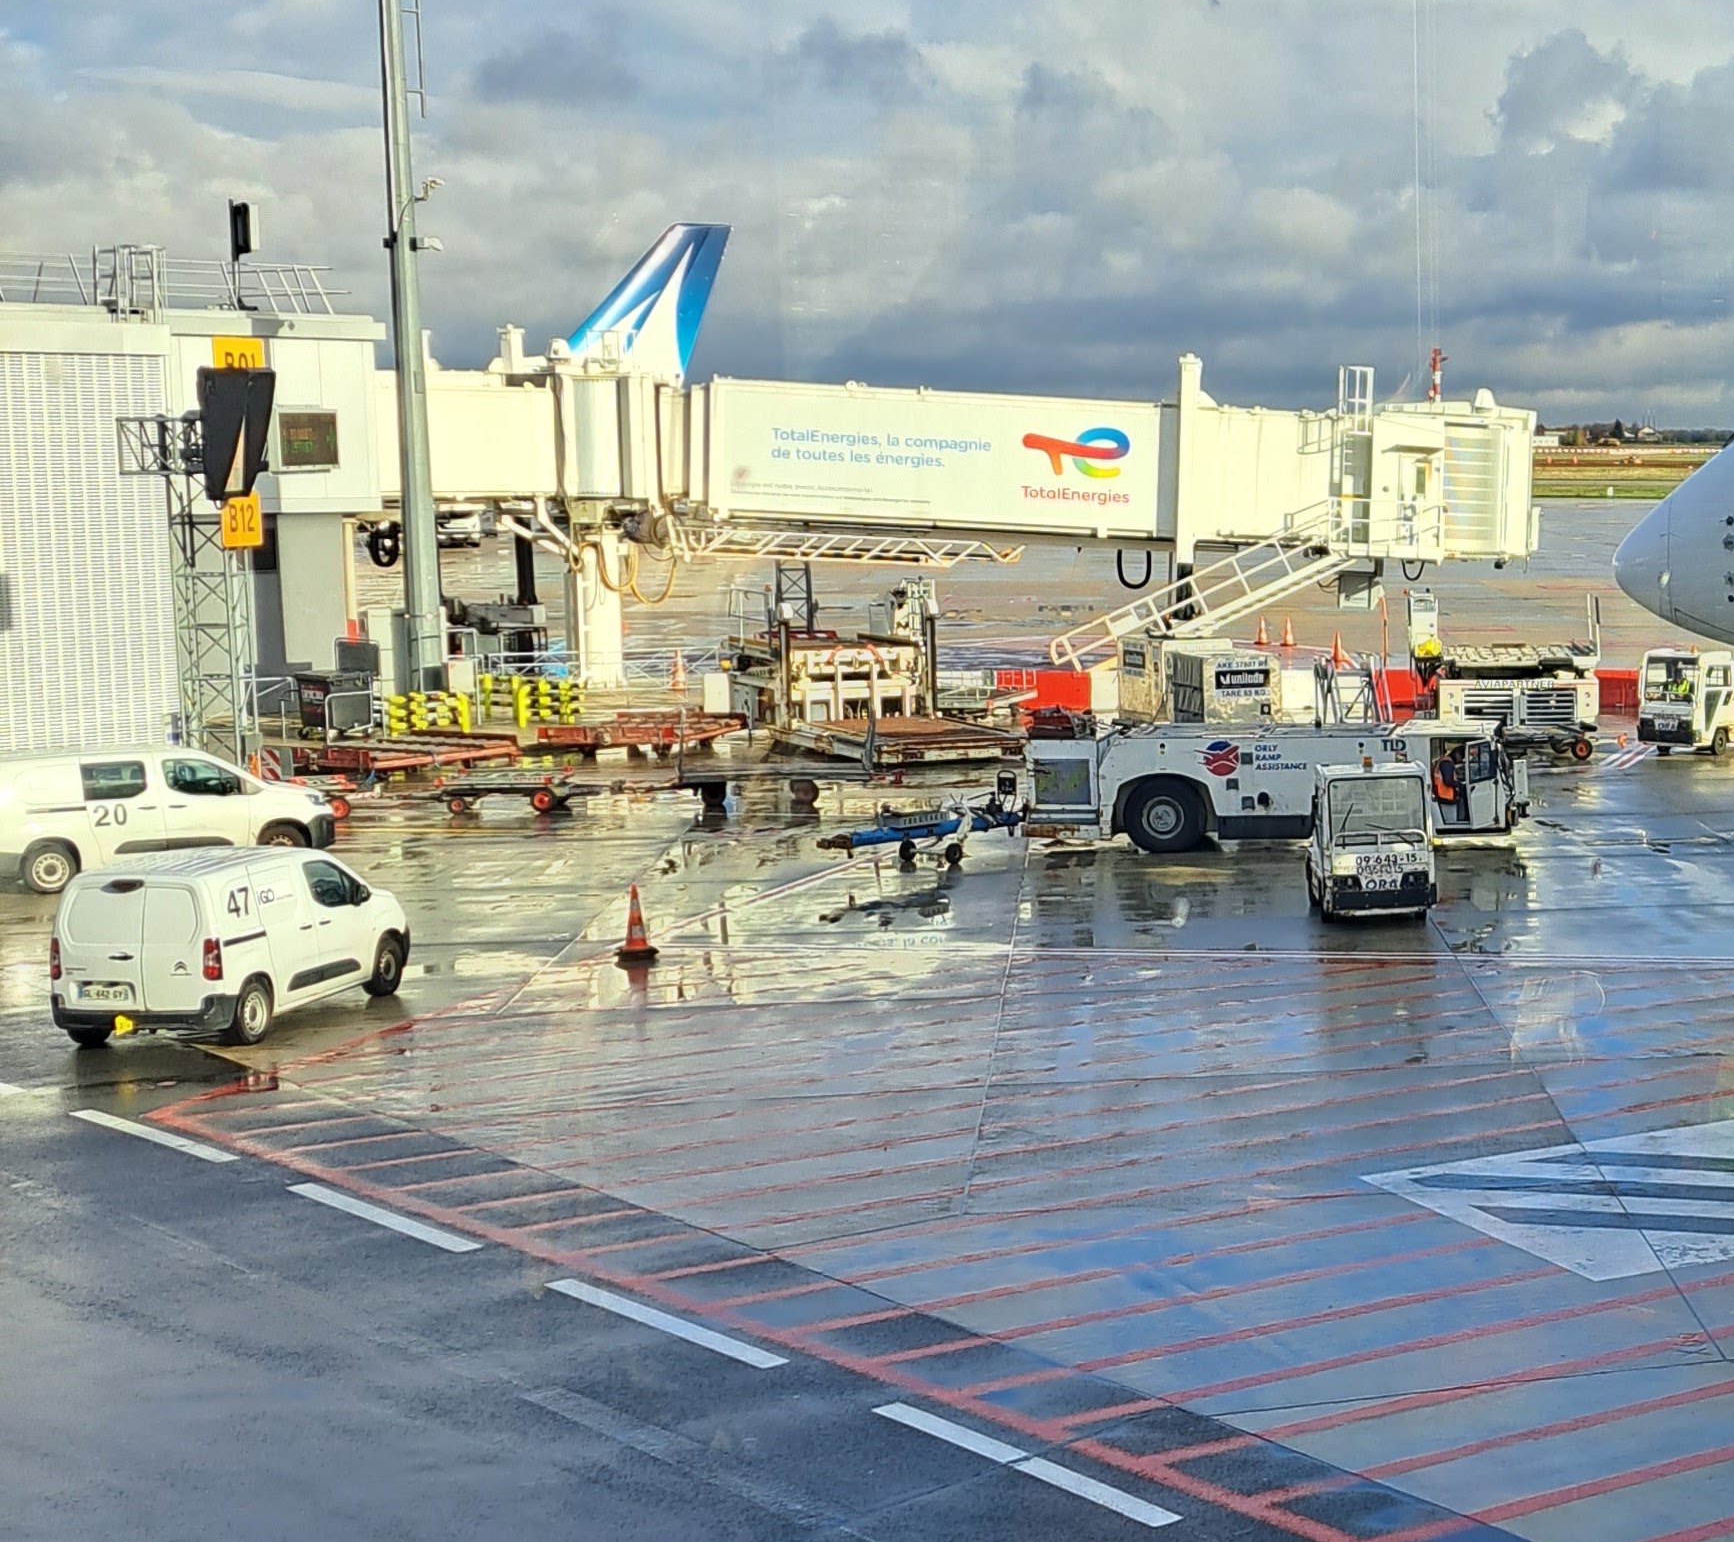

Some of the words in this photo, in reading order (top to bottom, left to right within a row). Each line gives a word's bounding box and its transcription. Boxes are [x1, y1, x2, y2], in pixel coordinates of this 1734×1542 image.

[771, 428, 882, 447] TotalEnergies,
[886, 433, 900, 447] la
[904, 437, 992, 453] compagnie
[770, 447, 791, 460] de
[796, 449, 845, 463] toutes
[850, 450, 871, 463] les
[876, 452, 946, 468] énergies.
[1021, 485, 1130, 505] TotalEnergies
[228, 503, 256, 533] B12
[1475, 679, 1555, 689] AVIAPARTNER
[1255, 744, 1278, 752] ORLY
[1381, 739, 1407, 752] TLD
[1255, 753, 1282, 761] RAMP
[1255, 762, 1308, 771] ASSISTANCE
[93, 803, 128, 827] 20
[227, 885, 249, 918] 47
